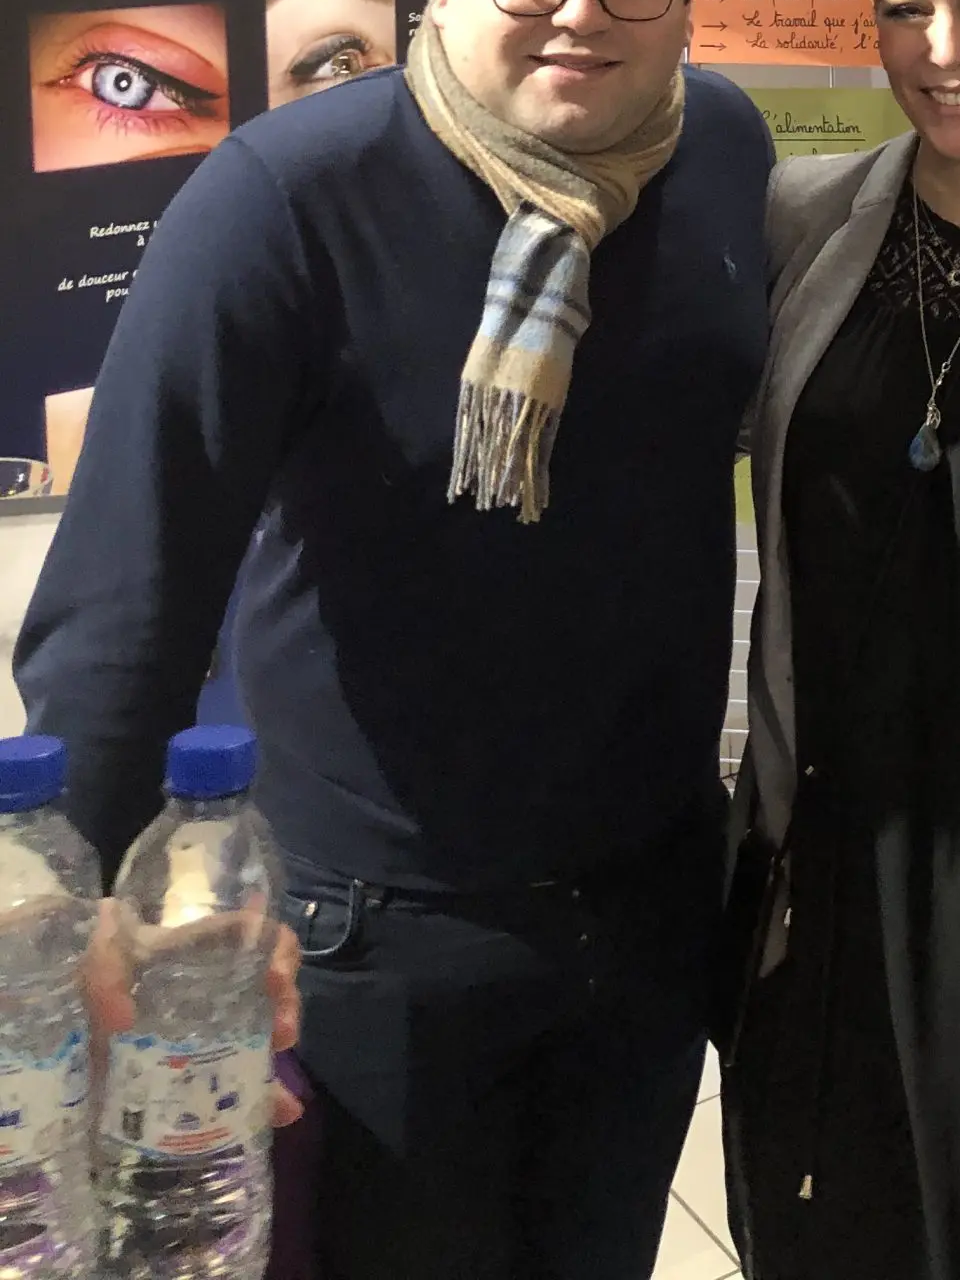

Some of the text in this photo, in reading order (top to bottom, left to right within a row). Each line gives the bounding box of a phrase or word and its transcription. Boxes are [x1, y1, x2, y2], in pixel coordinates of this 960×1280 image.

[742, 9, 878, 35] Le travail que j'ai
[746, 31, 769, 49] La
[89, 220, 150, 239] Redonnez
[137, 234, 145, 247] à
[57, 278, 74, 292] de
[78, 270, 129, 288] douceur
[105, 286, 129, 303] pou
